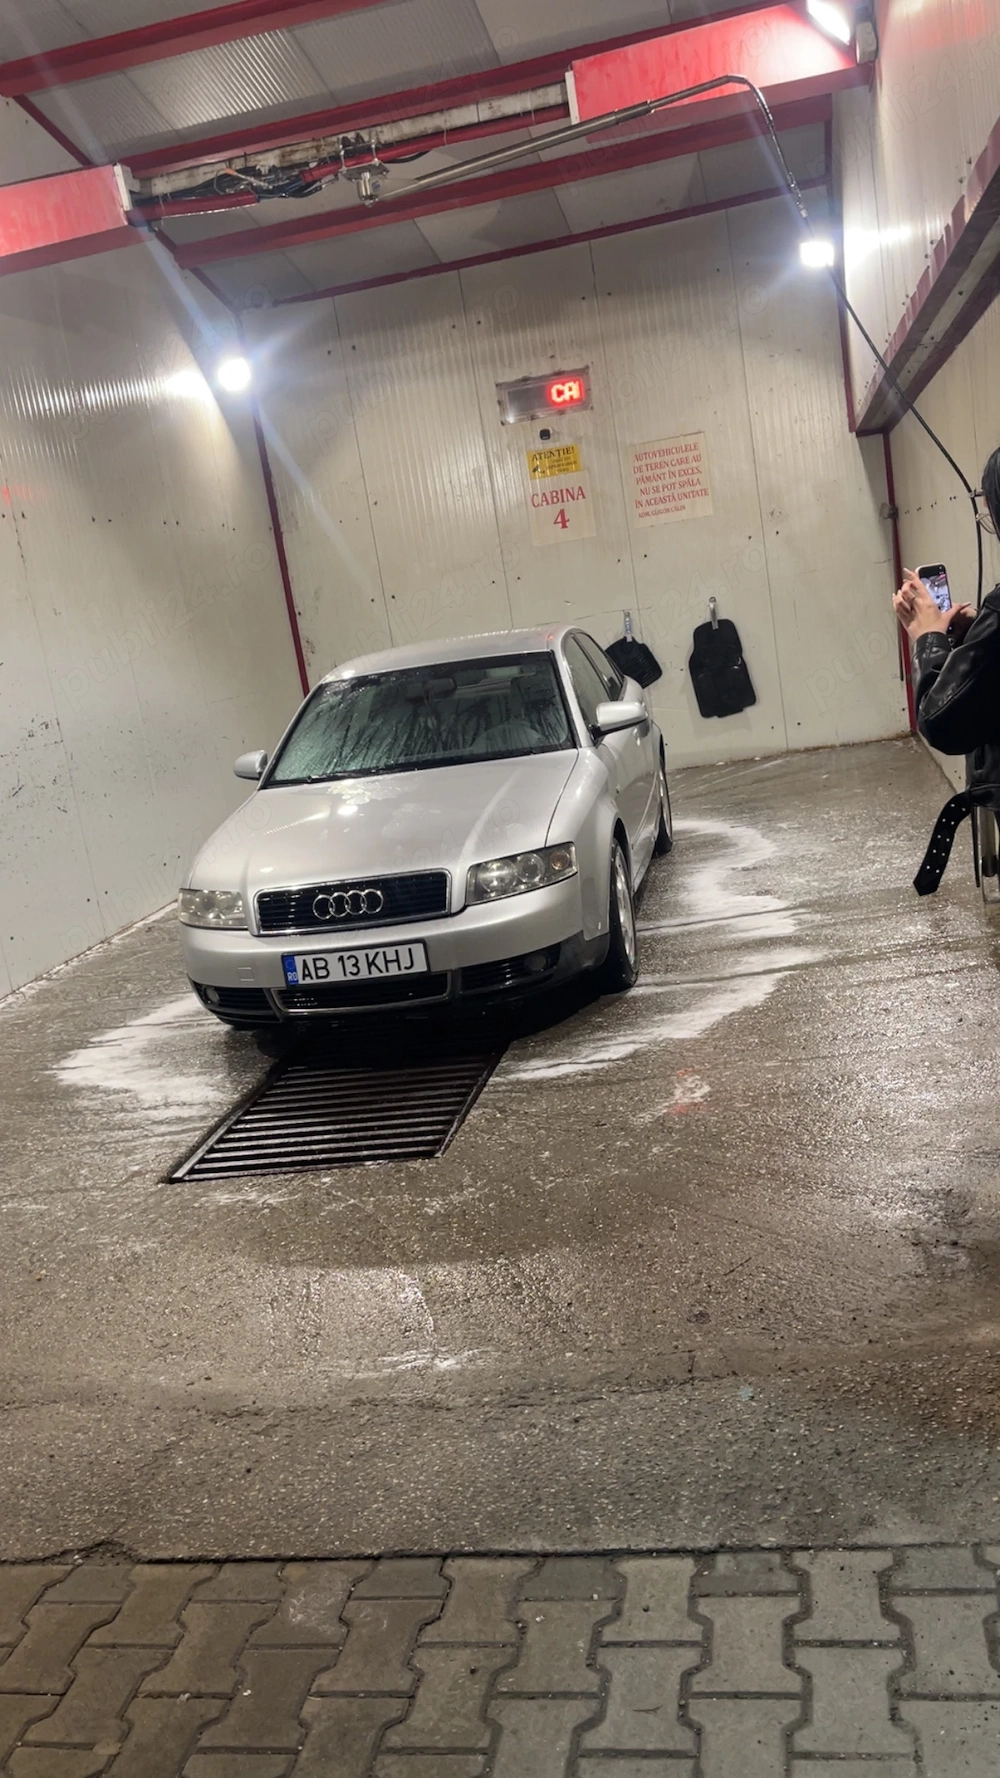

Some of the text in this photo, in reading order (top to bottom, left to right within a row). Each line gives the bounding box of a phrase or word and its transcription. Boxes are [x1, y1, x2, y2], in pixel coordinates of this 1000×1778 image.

[633, 442, 699, 463] AUTOVEHICULELE
[633, 453, 702, 475] DE TEREN CARE AU
[531, 485, 586, 508] CABINA
[640, 486, 651, 496] NU
[652, 484, 661, 494] SE
[661, 482, 677, 492] POT
[677, 487, 709, 501] UNITATE
[553, 508, 570, 530] 4
[302, 948, 415, 981] AB 13 KHJ
[287, 972, 298, 982] RO
